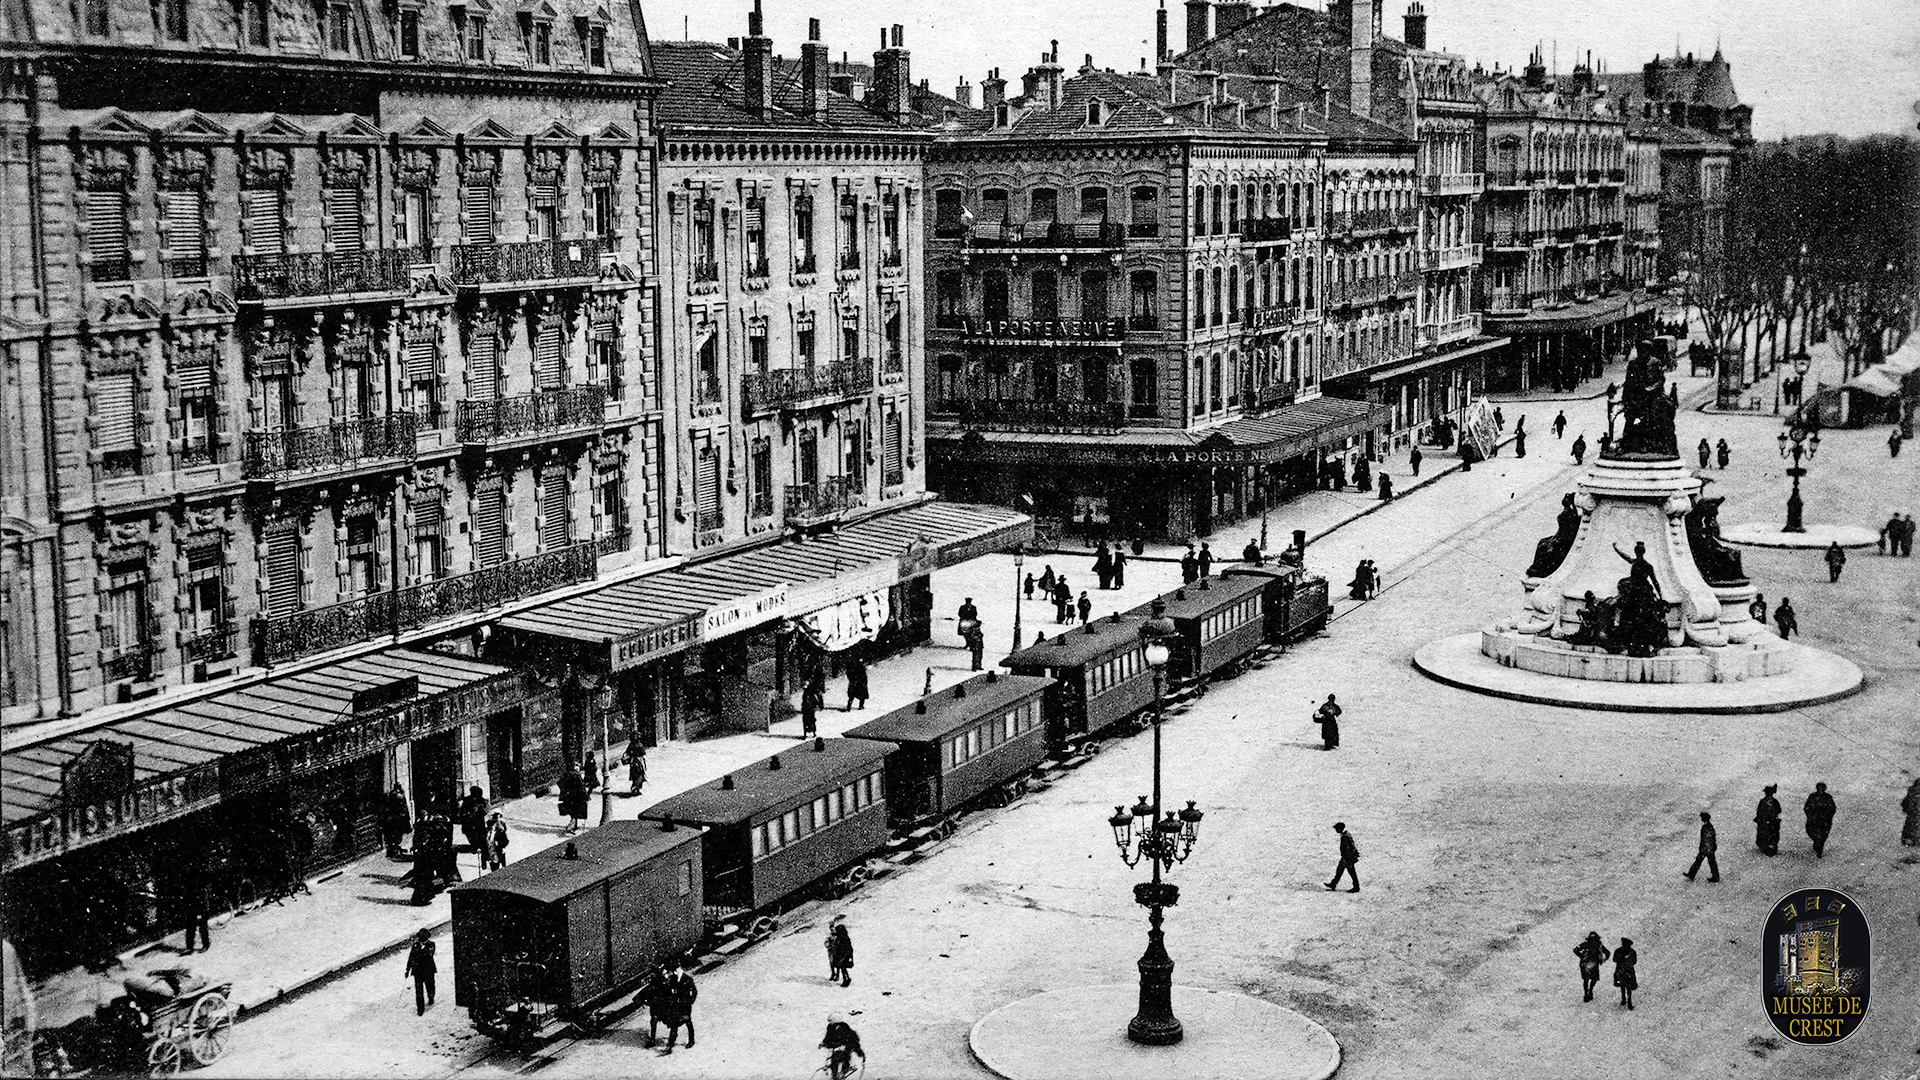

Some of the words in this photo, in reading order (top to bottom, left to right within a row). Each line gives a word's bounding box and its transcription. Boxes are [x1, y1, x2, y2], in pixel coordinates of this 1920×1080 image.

[1000, 320, 1053, 336] PORTE
[1060, 320, 1116, 337] NEUVE
[1155, 451, 1179, 463] LA
[1185, 450, 1245, 463] PORTE
[708, 608, 740, 630] SALON
[756, 592, 786, 614] MODES
